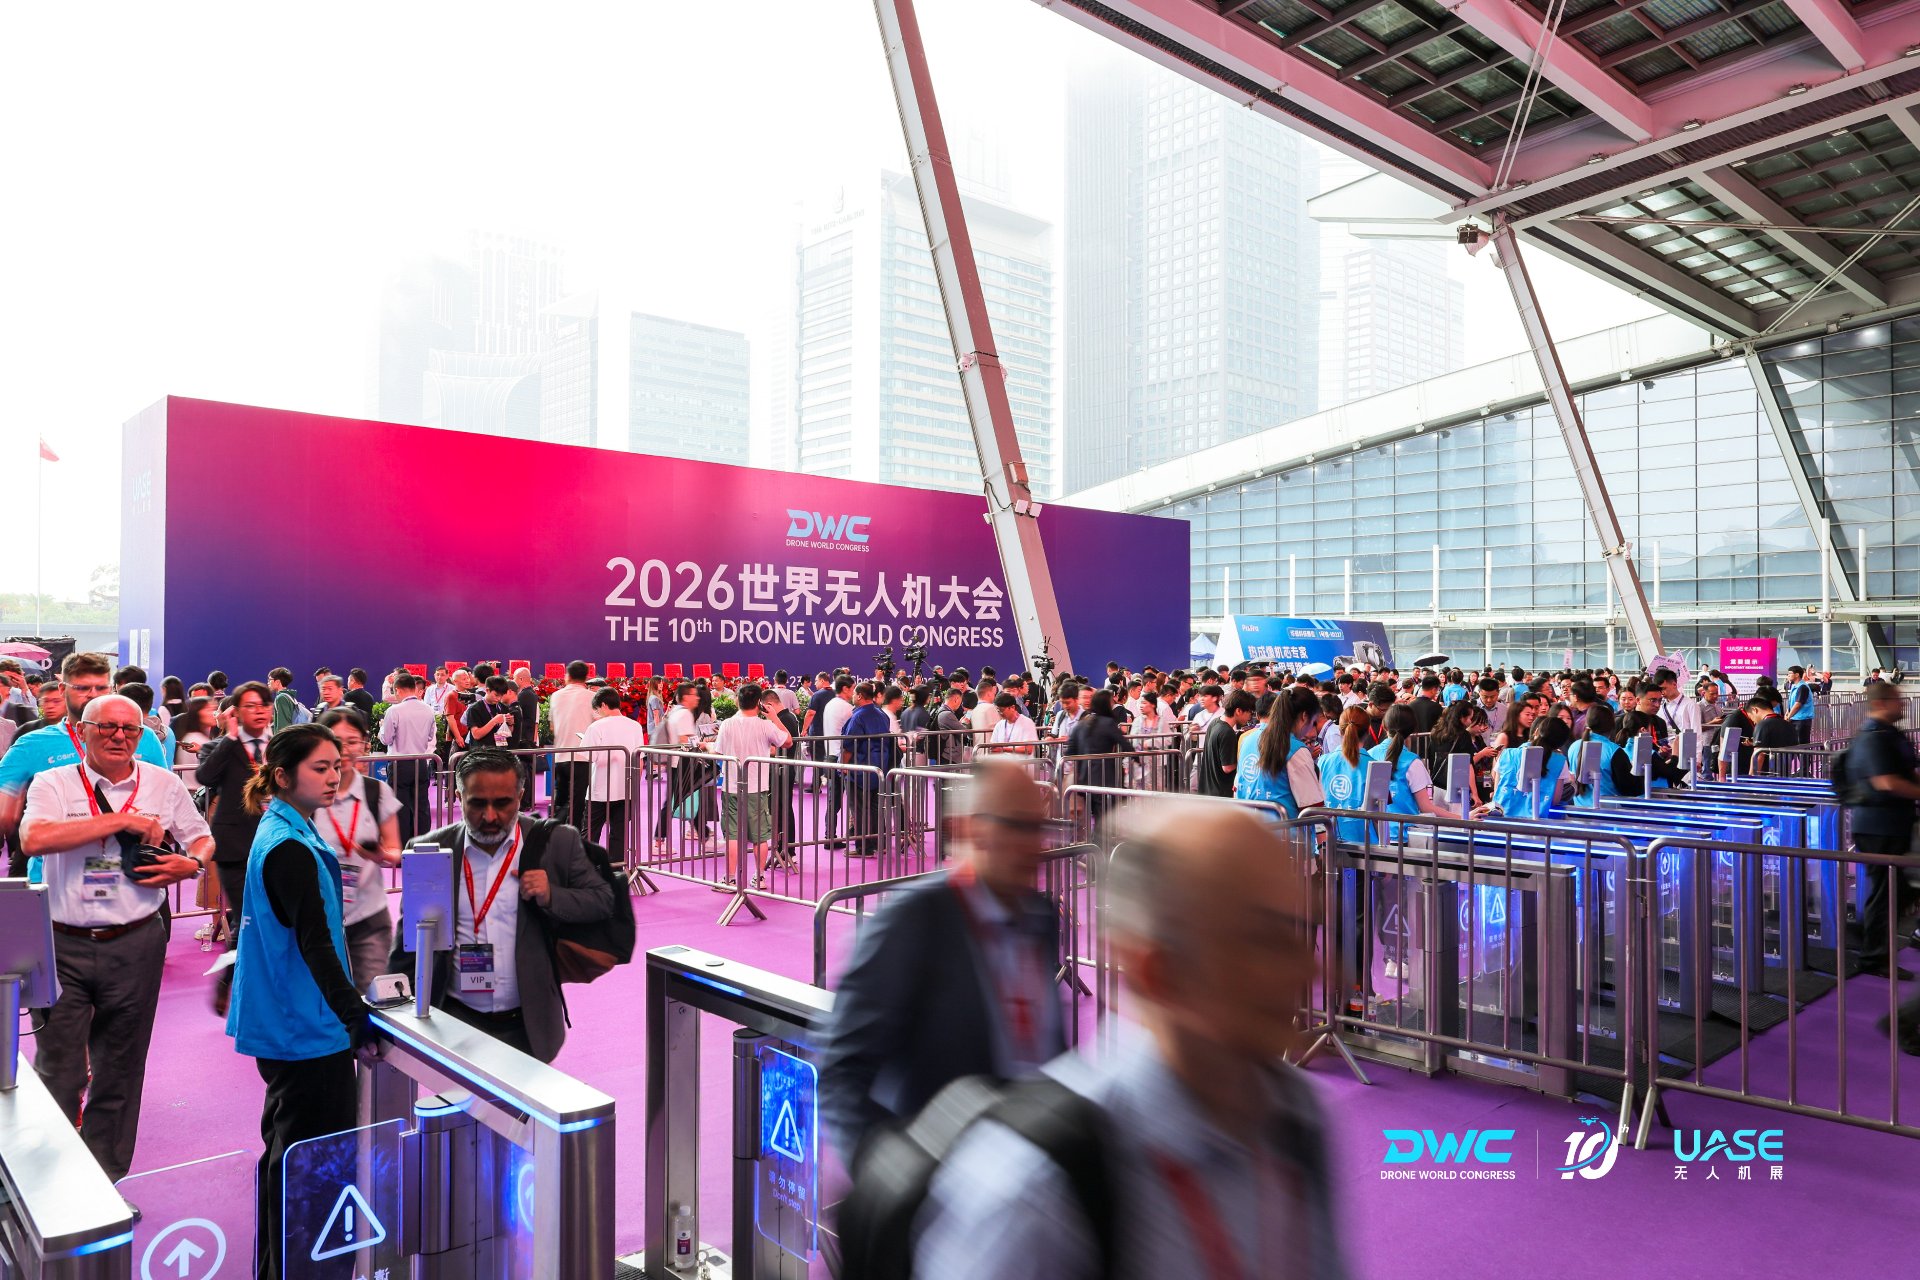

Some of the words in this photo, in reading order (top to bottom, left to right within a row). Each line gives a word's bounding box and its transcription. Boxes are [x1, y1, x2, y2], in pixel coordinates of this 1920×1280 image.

[786, 508, 871, 543] DWC
[785, 539, 809, 549] DRONE
[810, 540, 834, 551] WORLD
[835, 542, 870, 553] CONGRESS
[604, 556, 1004, 622] 2026世界无人机大会
[605, 616, 659, 642] THE
[668, 617, 712, 643] 10th
[720, 619, 805, 645] DRONE
[811, 621, 893, 647] WORLD
[899, 623, 1004, 648] CONGRESS
[1238, 784, 1271, 799] TAFF
[1501, 787, 1549, 802] STAF
[470, 976, 485, 984] VIP
